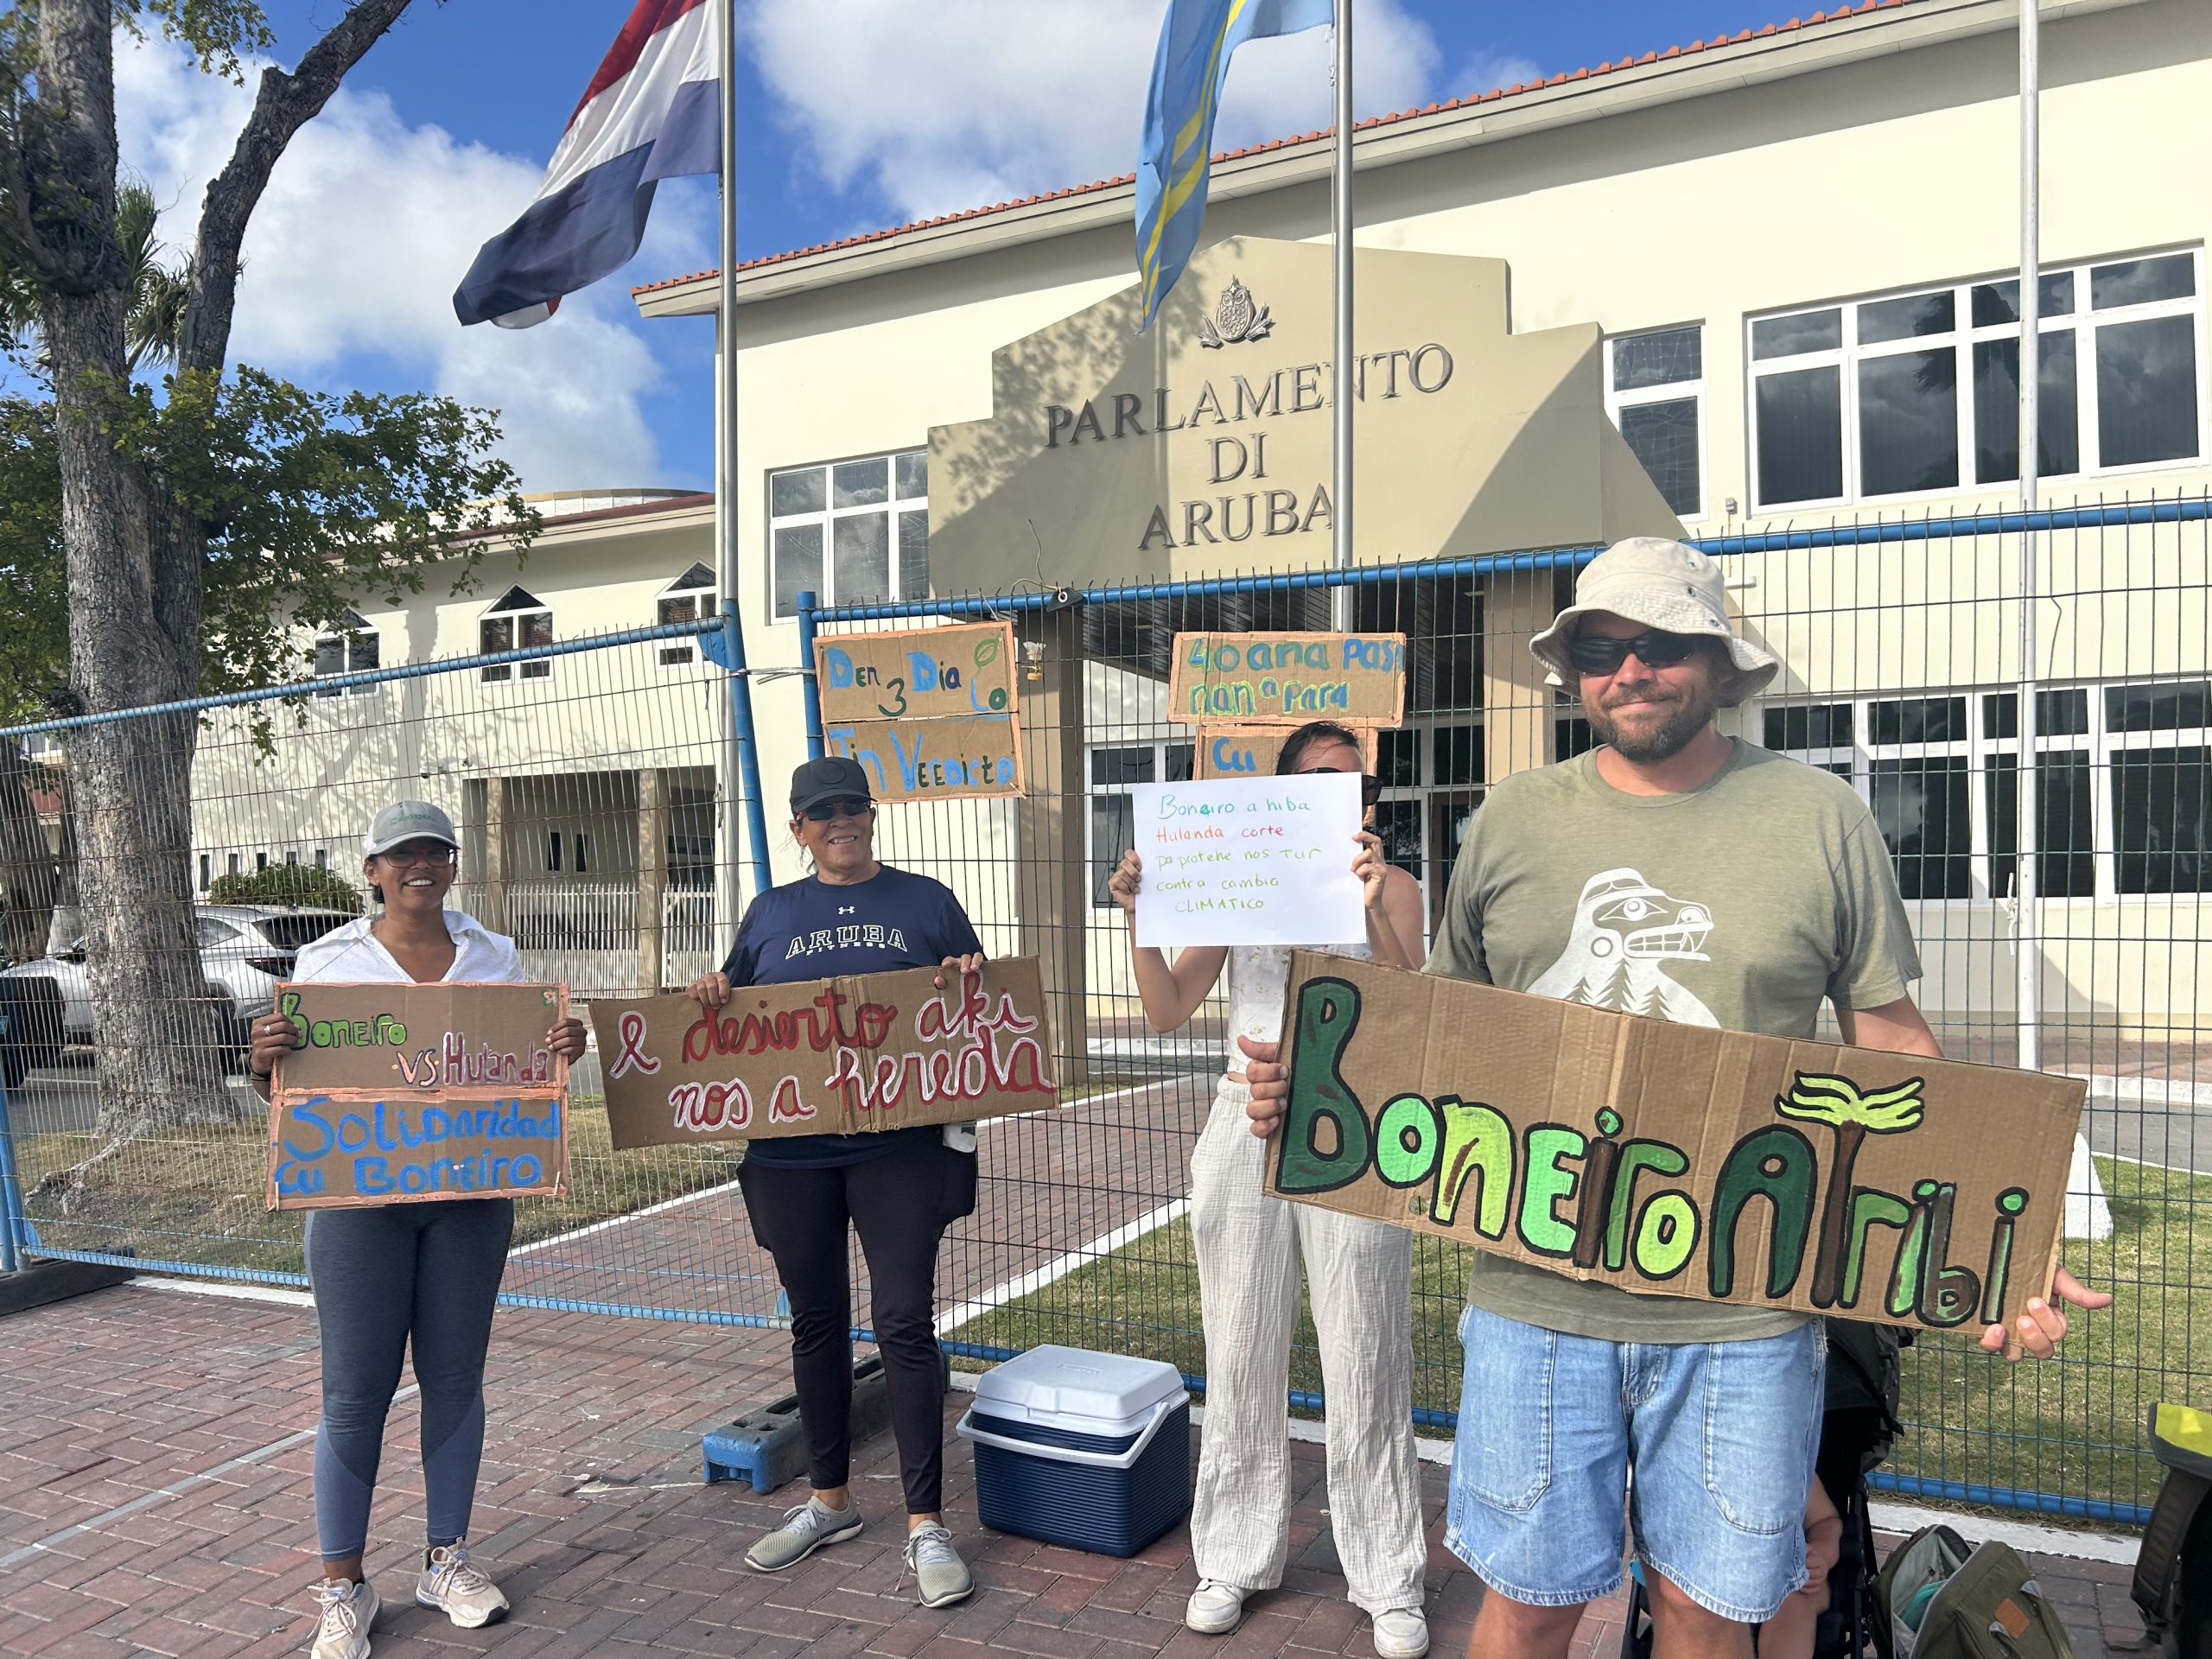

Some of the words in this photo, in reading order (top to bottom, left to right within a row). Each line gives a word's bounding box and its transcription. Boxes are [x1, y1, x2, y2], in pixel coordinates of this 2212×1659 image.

[1044, 343, 1453, 448] PARLAMENTO
[1206, 431, 1268, 484] DI
[1137, 482, 1334, 551] ARUBA
[878, 677, 906, 716] 3
[1247, 803, 1258, 813] a
[1267, 797, 1312, 812] hiba
[1156, 825, 1224, 843] Hulanda
[1242, 824, 1285, 838] corte
[1179, 849, 1231, 870] protehe
[1244, 848, 1270, 861] nos
[1156, 877, 1206, 892] contra
[1222, 873, 1279, 890] cambio
[1175, 898, 1264, 913] CLIMATICO
[785, 925, 908, 960] ARUBA
[682, 987, 899, 1065] desierto
[915, 969, 1039, 1043] aki
[443, 1032, 550, 1086] Hulanda
[668, 1077, 752, 1132] nos
[769, 1076, 817, 1124] a
[825, 1021, 1058, 1115] hereda
